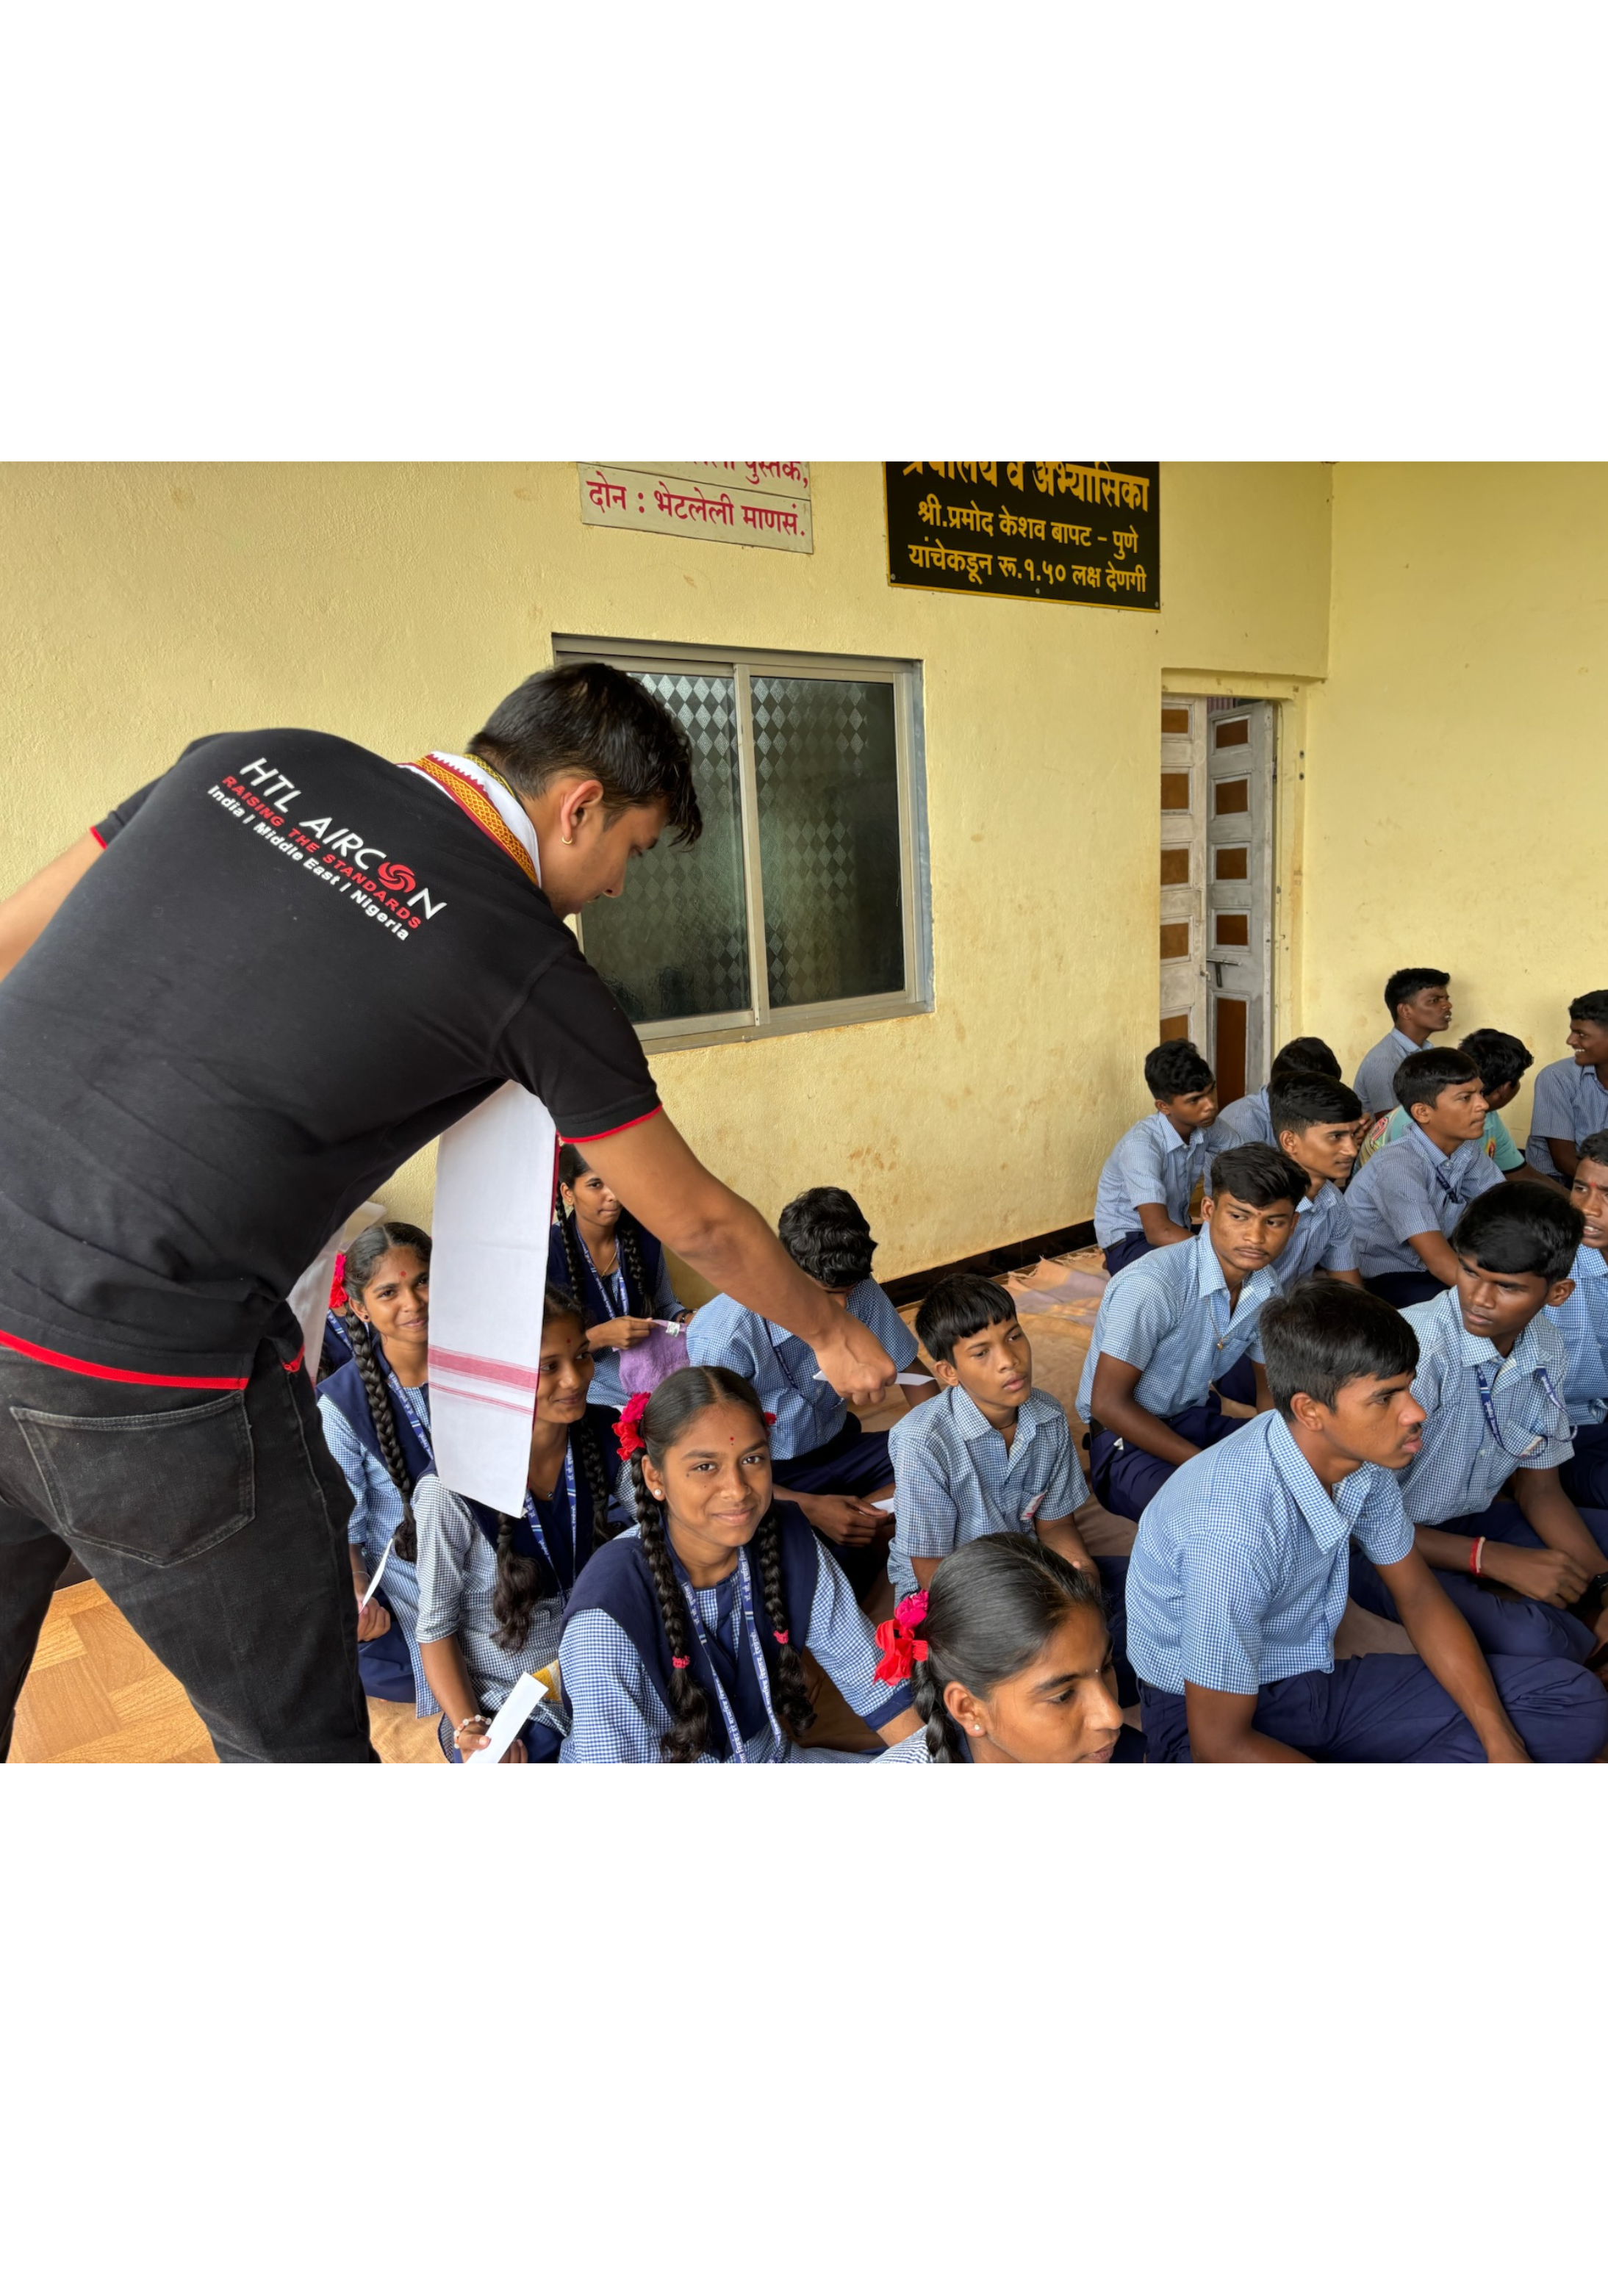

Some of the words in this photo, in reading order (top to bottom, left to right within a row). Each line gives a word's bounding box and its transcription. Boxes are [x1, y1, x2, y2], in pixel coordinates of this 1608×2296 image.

[586, 470, 627, 514] दोन
[654, 481, 734, 526] भेटलेली
[740, 503, 805, 536] माणसं.
[1006, 461, 1025, 492] व
[1032, 461, 1149, 512] अभ्यासिका
[999, 505, 1046, 541] केशव
[1051, 521, 1092, 547] बापट
[1113, 525, 1138, 560] पुणे
[908, 536, 992, 585] यांचेकडून
[1072, 564, 1101, 588] लक्ष
[1105, 561, 1146, 592] देणगी
[240, 757, 301, 813] HTL
[207, 785, 245, 818] India
[253, 821, 304, 862] Middle
[303, 857, 341, 885] East
[350, 890, 409, 941] Nigeria
[222, 776, 285, 827] RAISING
[288, 828, 320, 854] THE
[322, 854, 422, 929] STANDARDS
